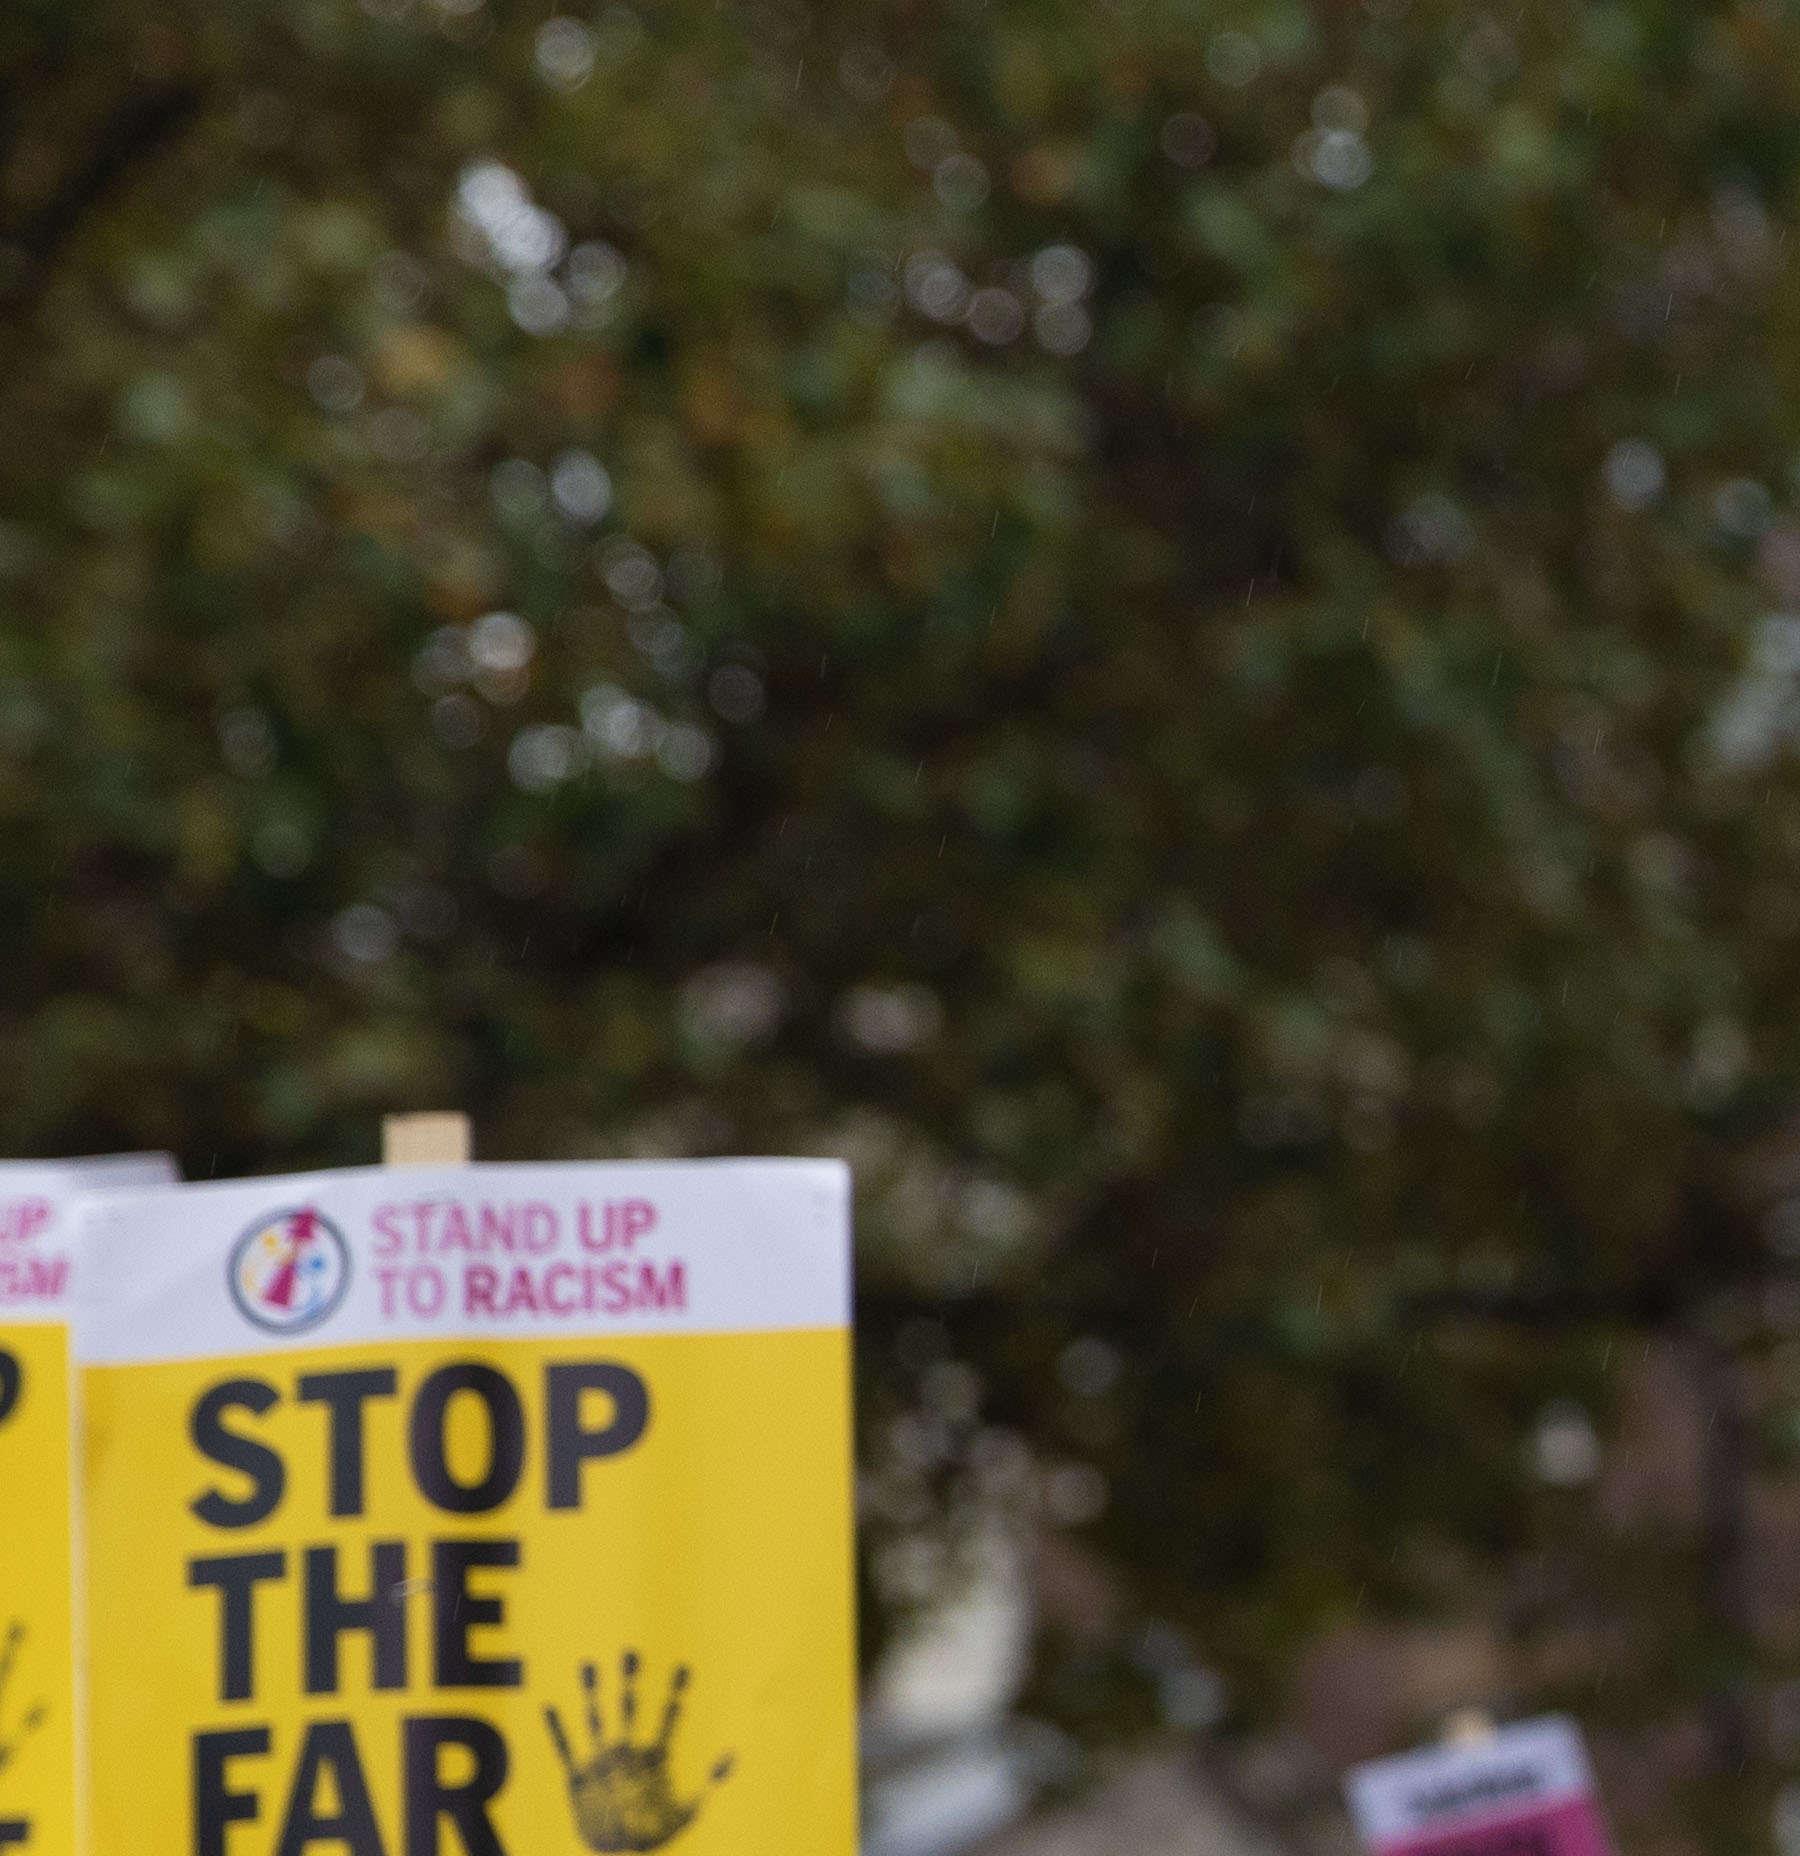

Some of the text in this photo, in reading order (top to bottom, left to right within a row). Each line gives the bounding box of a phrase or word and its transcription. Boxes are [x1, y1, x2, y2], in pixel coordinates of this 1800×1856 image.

[370, 1199, 658, 1257] STAND UP
[376, 1260, 688, 1320] TO RACISM
[187, 1355, 652, 1530] STOP
[186, 1537, 525, 1704] THE
